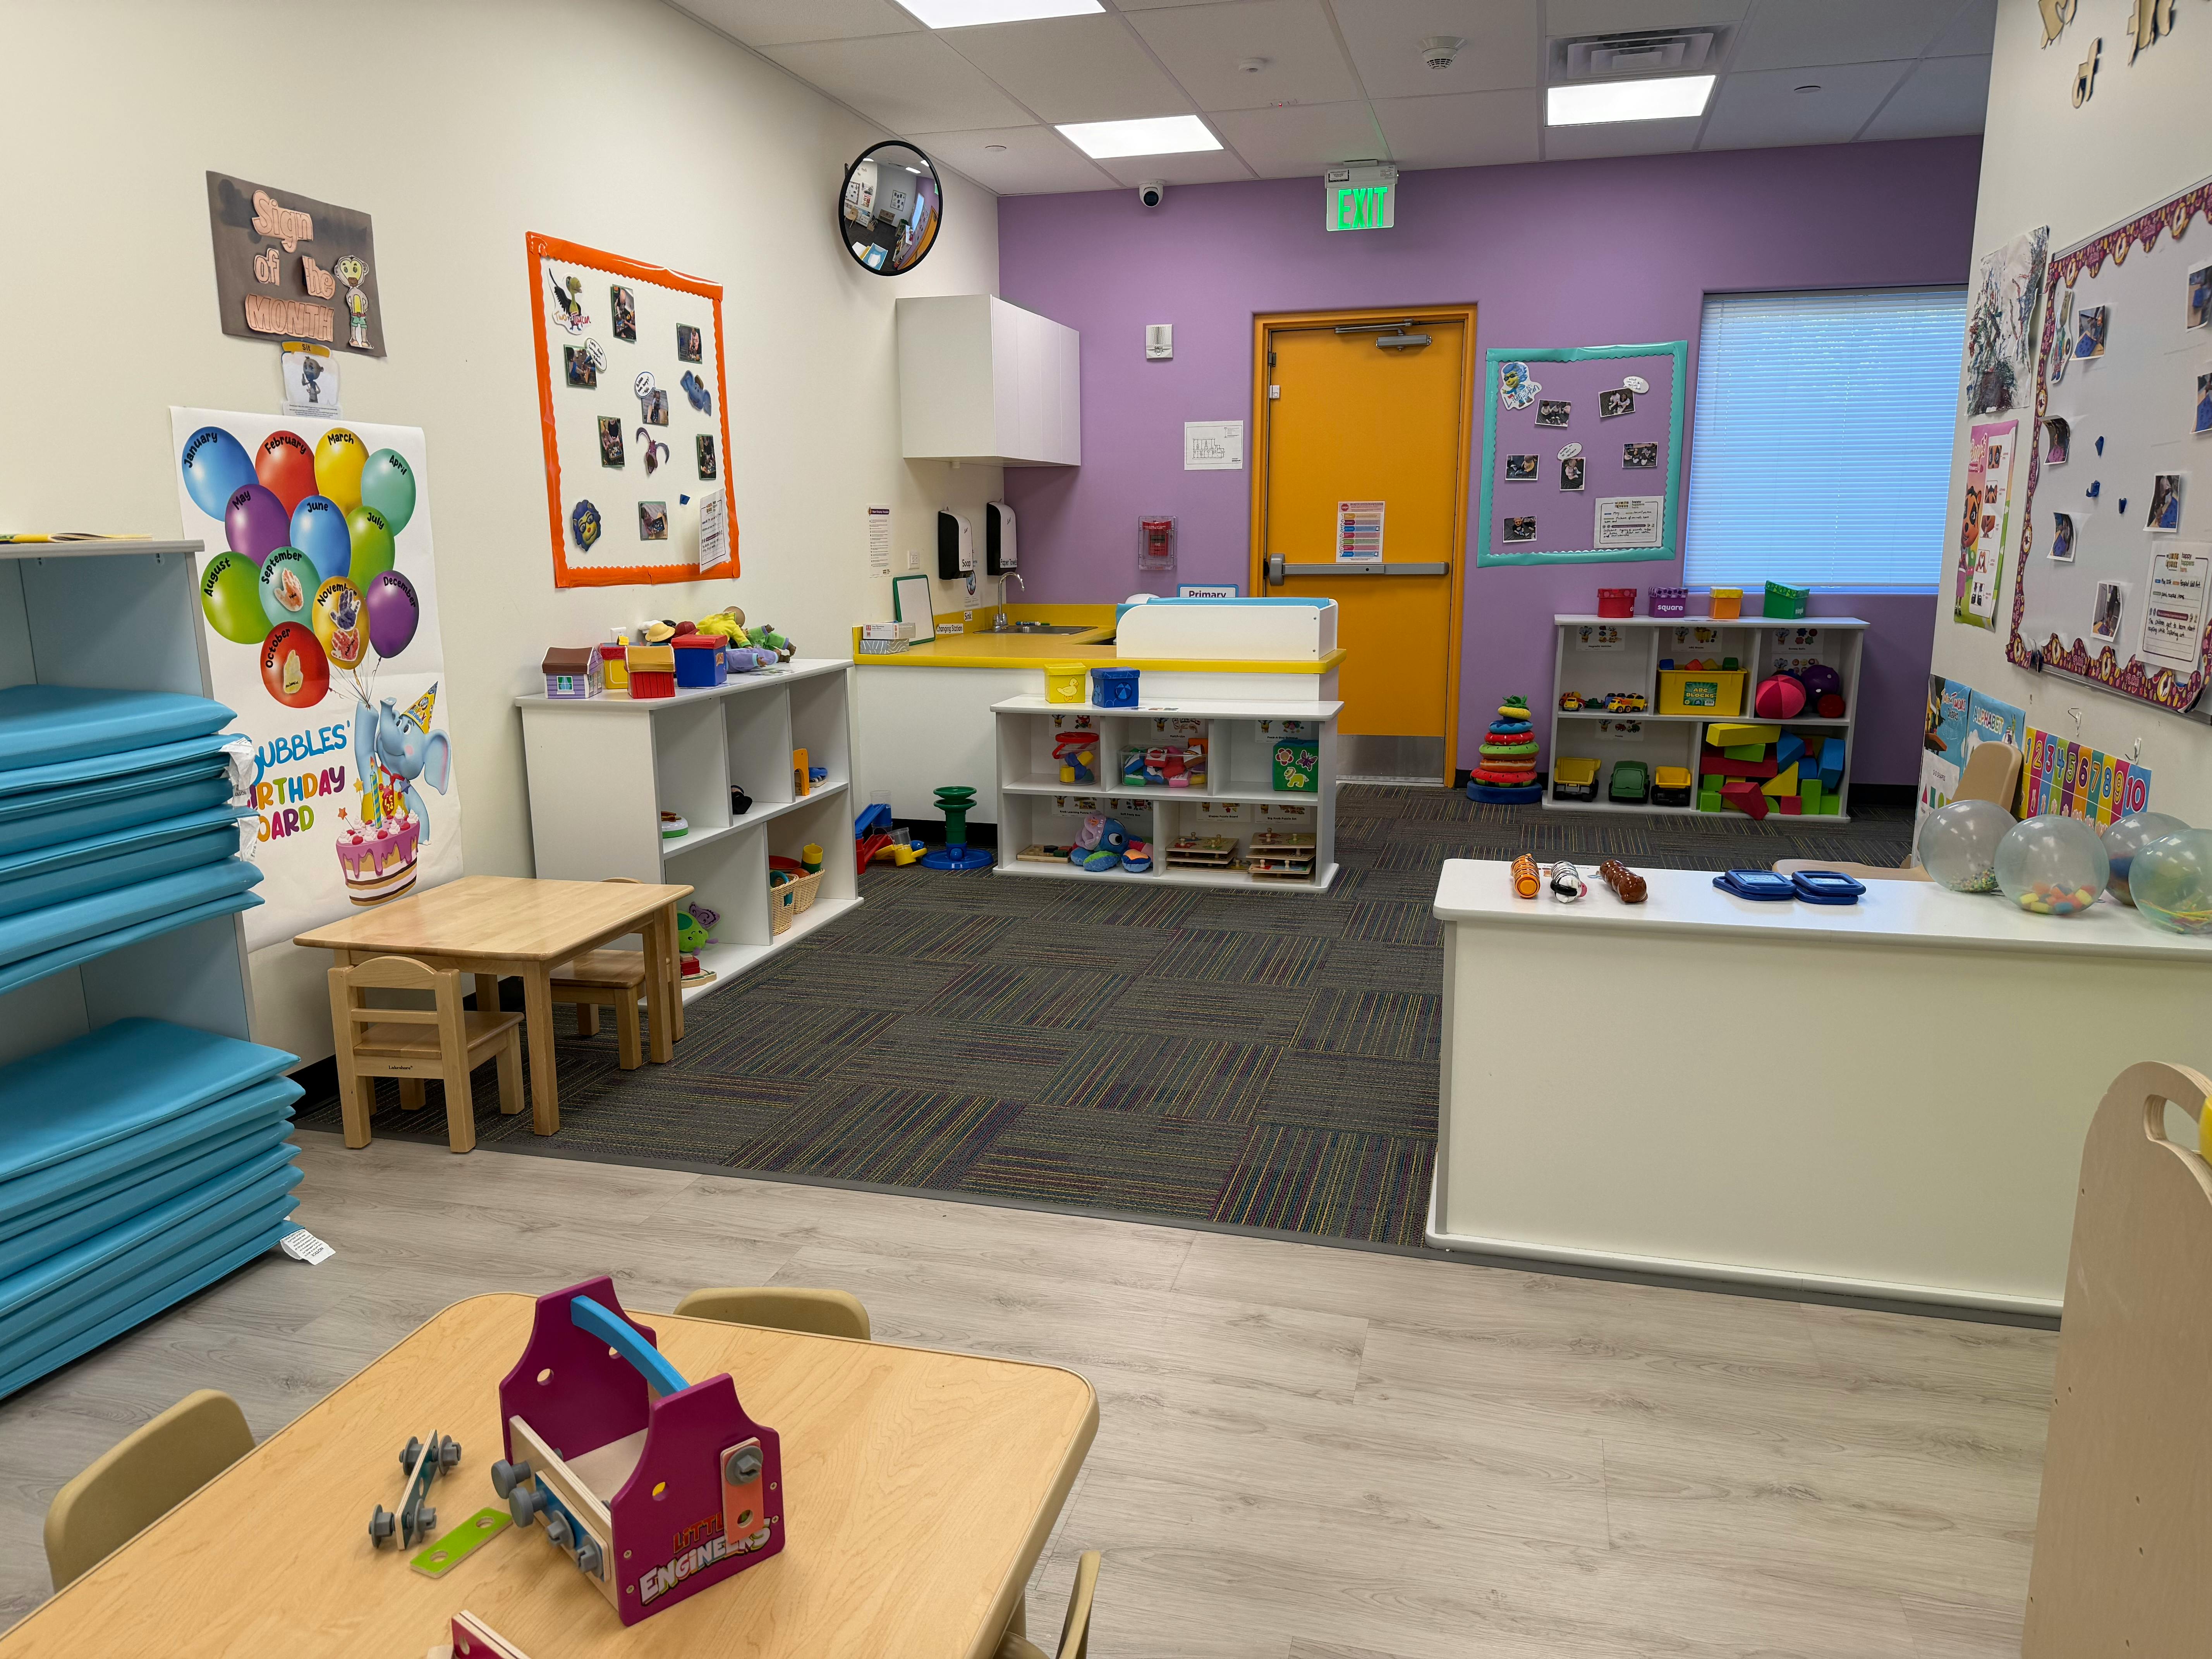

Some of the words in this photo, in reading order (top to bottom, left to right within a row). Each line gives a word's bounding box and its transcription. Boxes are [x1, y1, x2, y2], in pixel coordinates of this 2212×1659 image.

[253, 190, 313, 253] Sign
[1338, 187, 1388, 228] EXIT
[254, 248, 280, 285] of
[302, 255, 335, 300] the
[246, 294, 334, 341] MONTH
[302, 343, 311, 352] Sit
[184, 432, 218, 468] January
[264, 436, 307, 455] February
[327, 433, 354, 446] March
[389, 454, 407, 476] April
[232, 490, 251, 510] May
[306, 501, 329, 512] June
[367, 512, 385, 530] July
[203, 557, 231, 597] August
[261, 549, 302, 584] September
[962, 559, 971, 568] Soap
[383, 576, 416, 608] December
[264, 628, 291, 668] October
[1973, 706, 2004, 735] ALPHABET
[247, 766, 345, 810] IRTHDAY
[2026, 738, 2032, 764] 1
[2033, 740, 2042, 769] 2
[2045, 744, 2054, 774] 3
[2056, 747, 2064, 780] 4
[2066, 752, 2076, 783] 5
[2078, 757, 2088, 789] 6
[2091, 761, 2100, 793] 7
[2103, 766, 2112, 799] 8
[2114, 771, 2124, 805] 9
[2126, 776, 2145, 813] 10
[258, 805, 314, 842] OARD
[311, 1247, 324, 1257] NOTICE
[673, 1511, 724, 1554] LITTL
